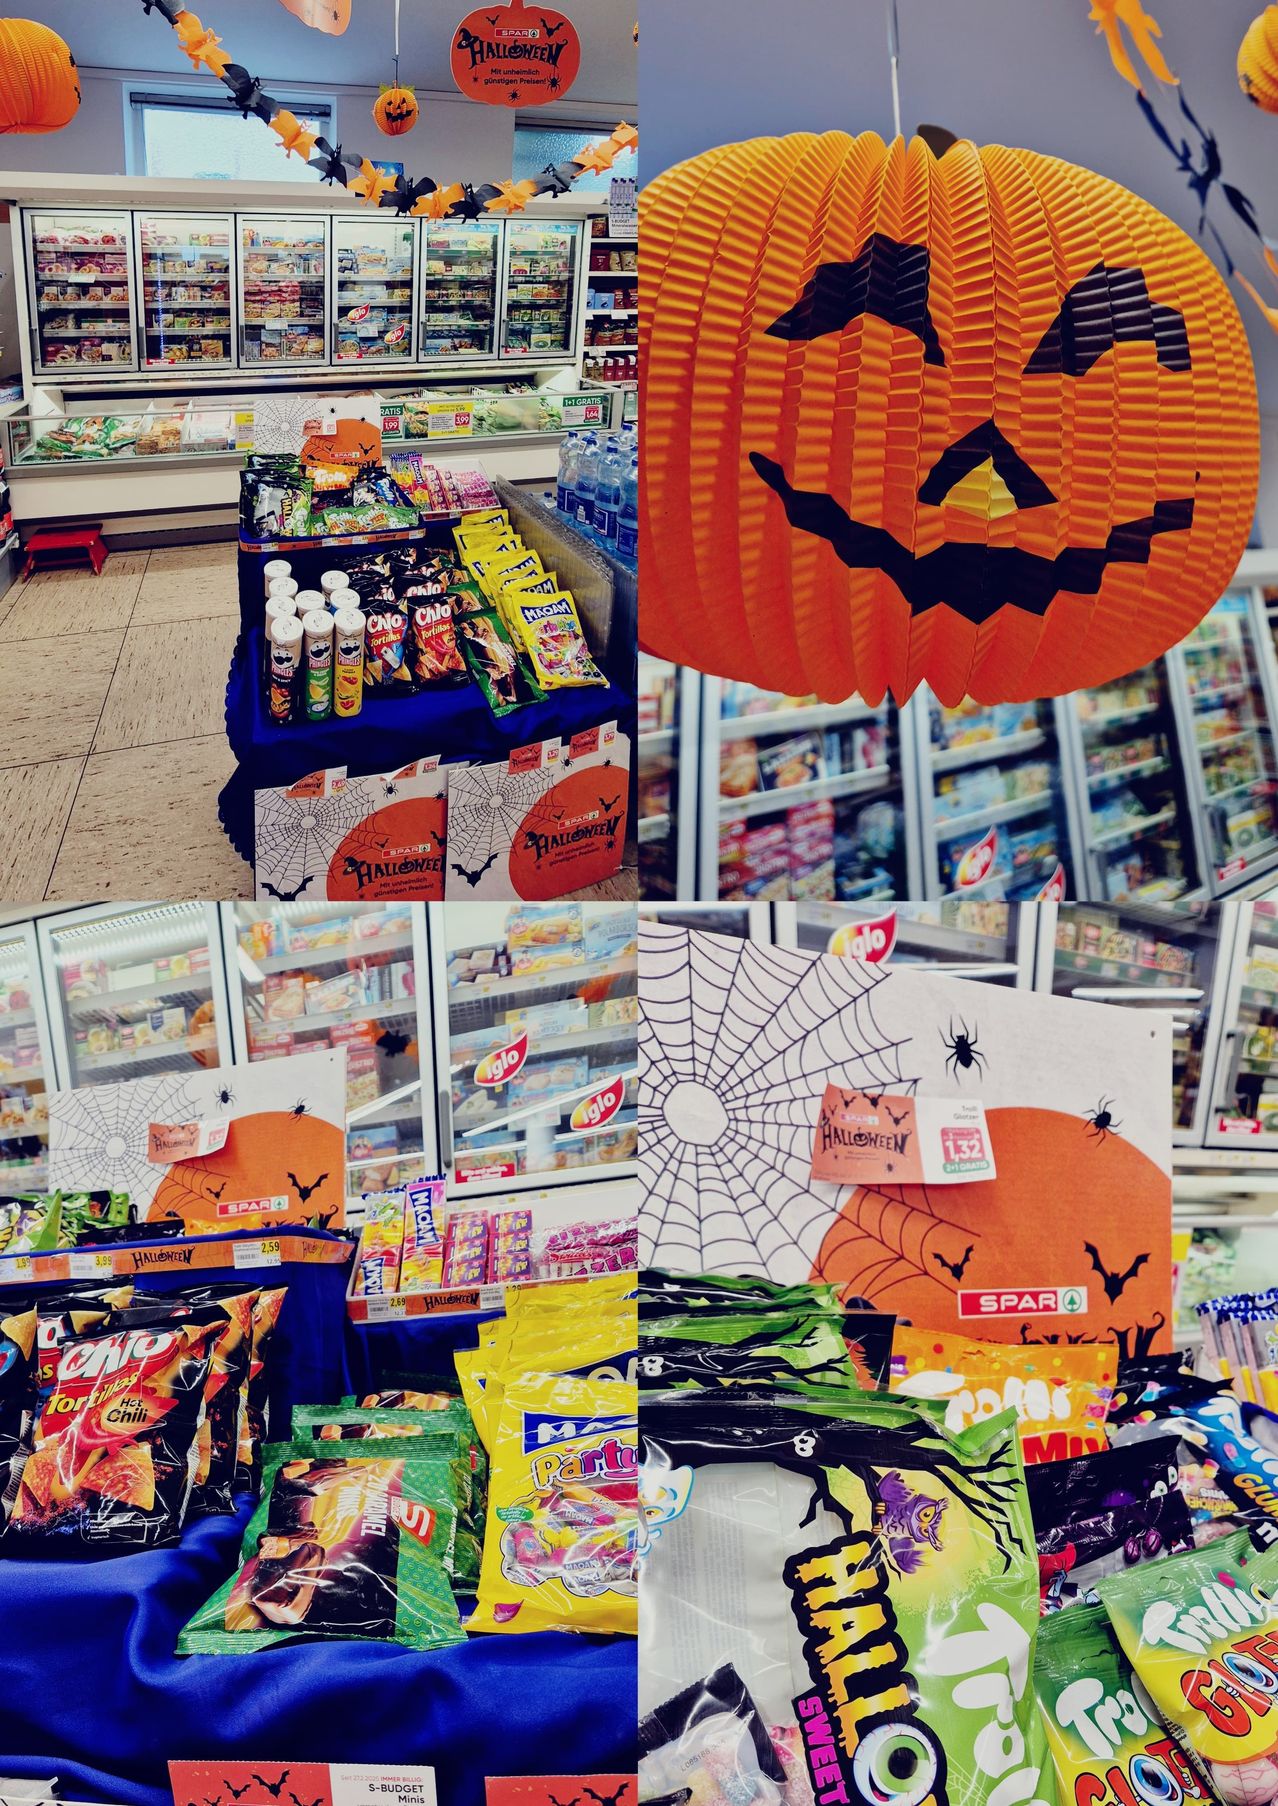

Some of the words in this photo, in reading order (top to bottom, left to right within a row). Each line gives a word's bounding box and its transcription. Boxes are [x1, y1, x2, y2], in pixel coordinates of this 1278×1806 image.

[468, 39, 568, 69] HALLOWEEN
[484, 77, 519, 86] günstigen
[519, 77, 547, 85] Preisen!
[490, 68, 502, 76] Mit
[503, 68, 540, 76] unheimlich
[351, 306, 366, 319] iglo
[389, 329, 402, 341] iglo
[576, 398, 602, 406] GRATIS
[415, 603, 452, 627] Chio
[525, 601, 571, 622] MAOAM
[366, 612, 403, 634] Chio
[420, 622, 451, 640] Tortillas
[370, 631, 401, 646] Tortillas
[565, 815, 589, 828] SPAR
[533, 810, 625, 862] HALLOWEEN
[389, 847, 420, 857] SPAR
[967, 845, 993, 882] iglo
[374, 887, 407, 898] günstigen
[407, 883, 434, 894] Preisen!
[380, 881, 392, 889] Mit
[393, 876, 428, 887] unheimlich
[845, 924, 887, 961] iglo
[486, 1049, 520, 1080] iglo
[582, 1091, 616, 1125] iglo
[821, 1126, 913, 1157] HALLOWEEN
[945, 1140, 982, 1162] 1,32
[945, 1163, 959, 1173] 2+1
[959, 1161, 988, 1171] GRATIS
[227, 1200, 271, 1214] SPAR
[412, 1191, 436, 1247] MAOAM
[261, 1240, 280, 1254] 2,59
[16, 1257, 31, 1268] 1,99
[95, 1255, 113, 1267] 3,99
[131, 1246, 196, 1270] HALLOWEEN
[390, 1297, 406, 1308] 2,69
[424, 1292, 480, 1312] HALLOWEEN
[979, 1292, 1057, 1313] SPAR
[57, 1331, 176, 1381] Chio
[45, 1372, 139, 1416] Tortillas
[119, 1397, 143, 1408] Hot
[106, 1407, 149, 1424] Chili
[400, 1504, 431, 1537] S
[1142, 1571, 1267, 1656] Trolli
[794, 1540, 938, 1806] HALLO
[797, 1696, 851, 1805] SWEET
[368, 1783, 425, 1793] S-BUDGET
[398, 1795, 425, 1804] Minis
